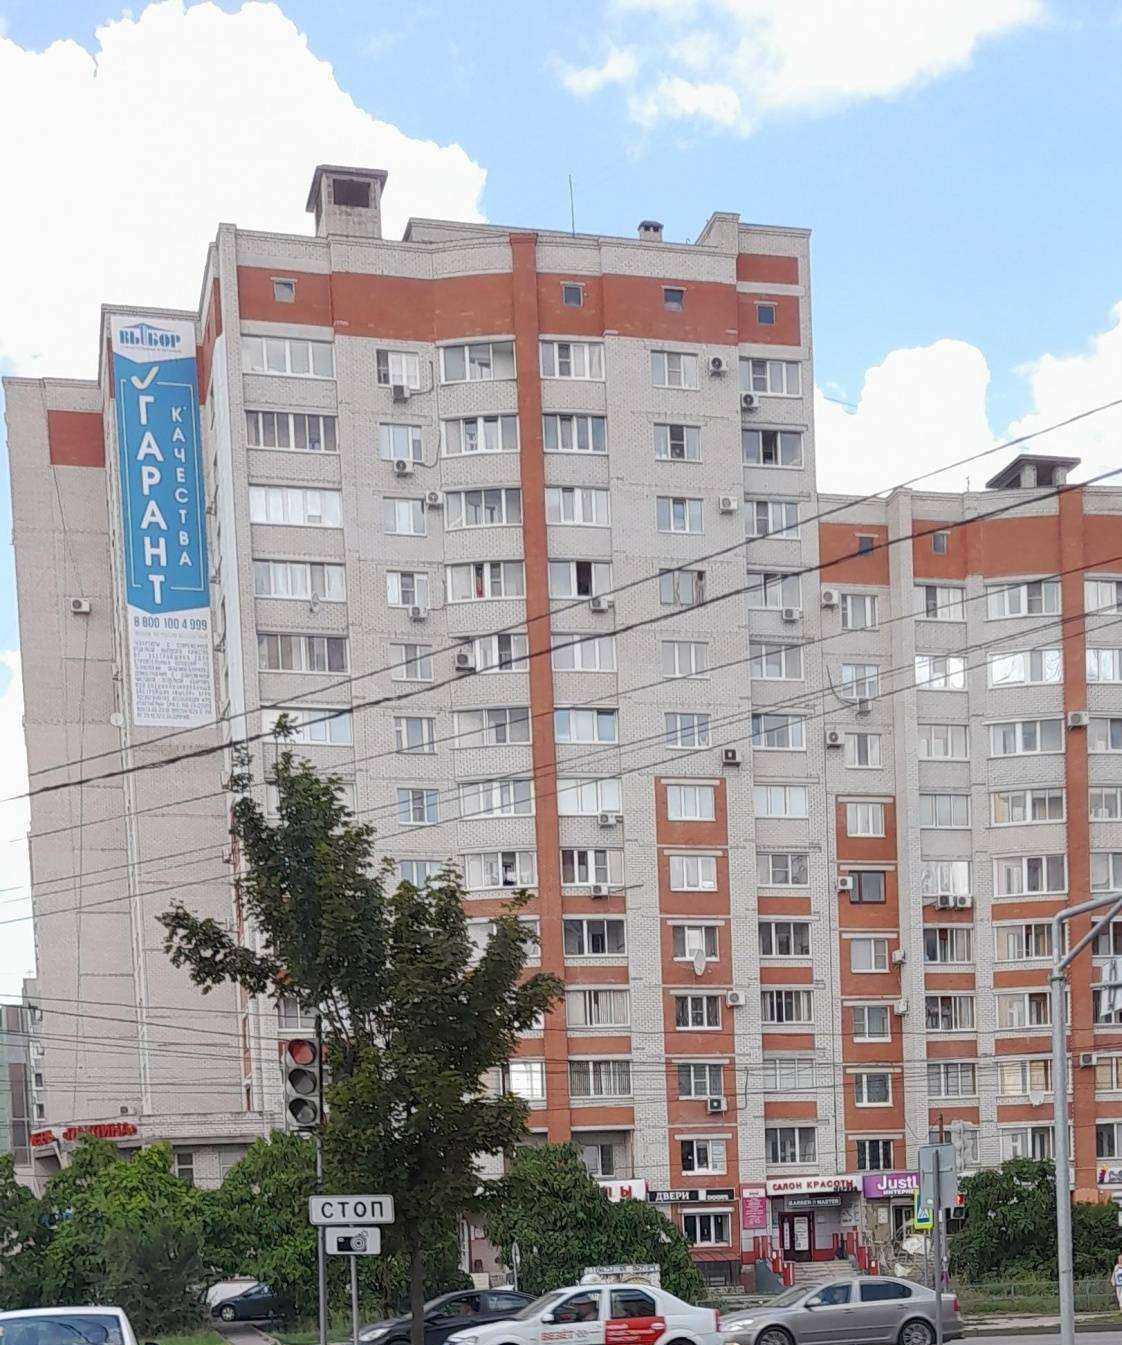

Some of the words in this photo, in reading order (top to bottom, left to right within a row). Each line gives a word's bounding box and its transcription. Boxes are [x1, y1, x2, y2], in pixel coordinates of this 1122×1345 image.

[119, 323, 182, 348] ВЫБОР
[171, 406, 193, 566] КАЧЕСТВА
[136, 395, 168, 604] ГАРАНТ
[134, 616, 140, 627] 8
[143, 617, 160, 629] 800
[164, 618, 180, 629] 100
[182, 619, 188, 630] 4
[190, 619, 208, 631] 999
[772, 1182, 802, 1191] САЛОН
[806, 1179, 854, 1190] КРАСОТЫ
[655, 1191, 690, 1202] ДВЕРИ
[321, 1201, 384, 1218] СТОП
